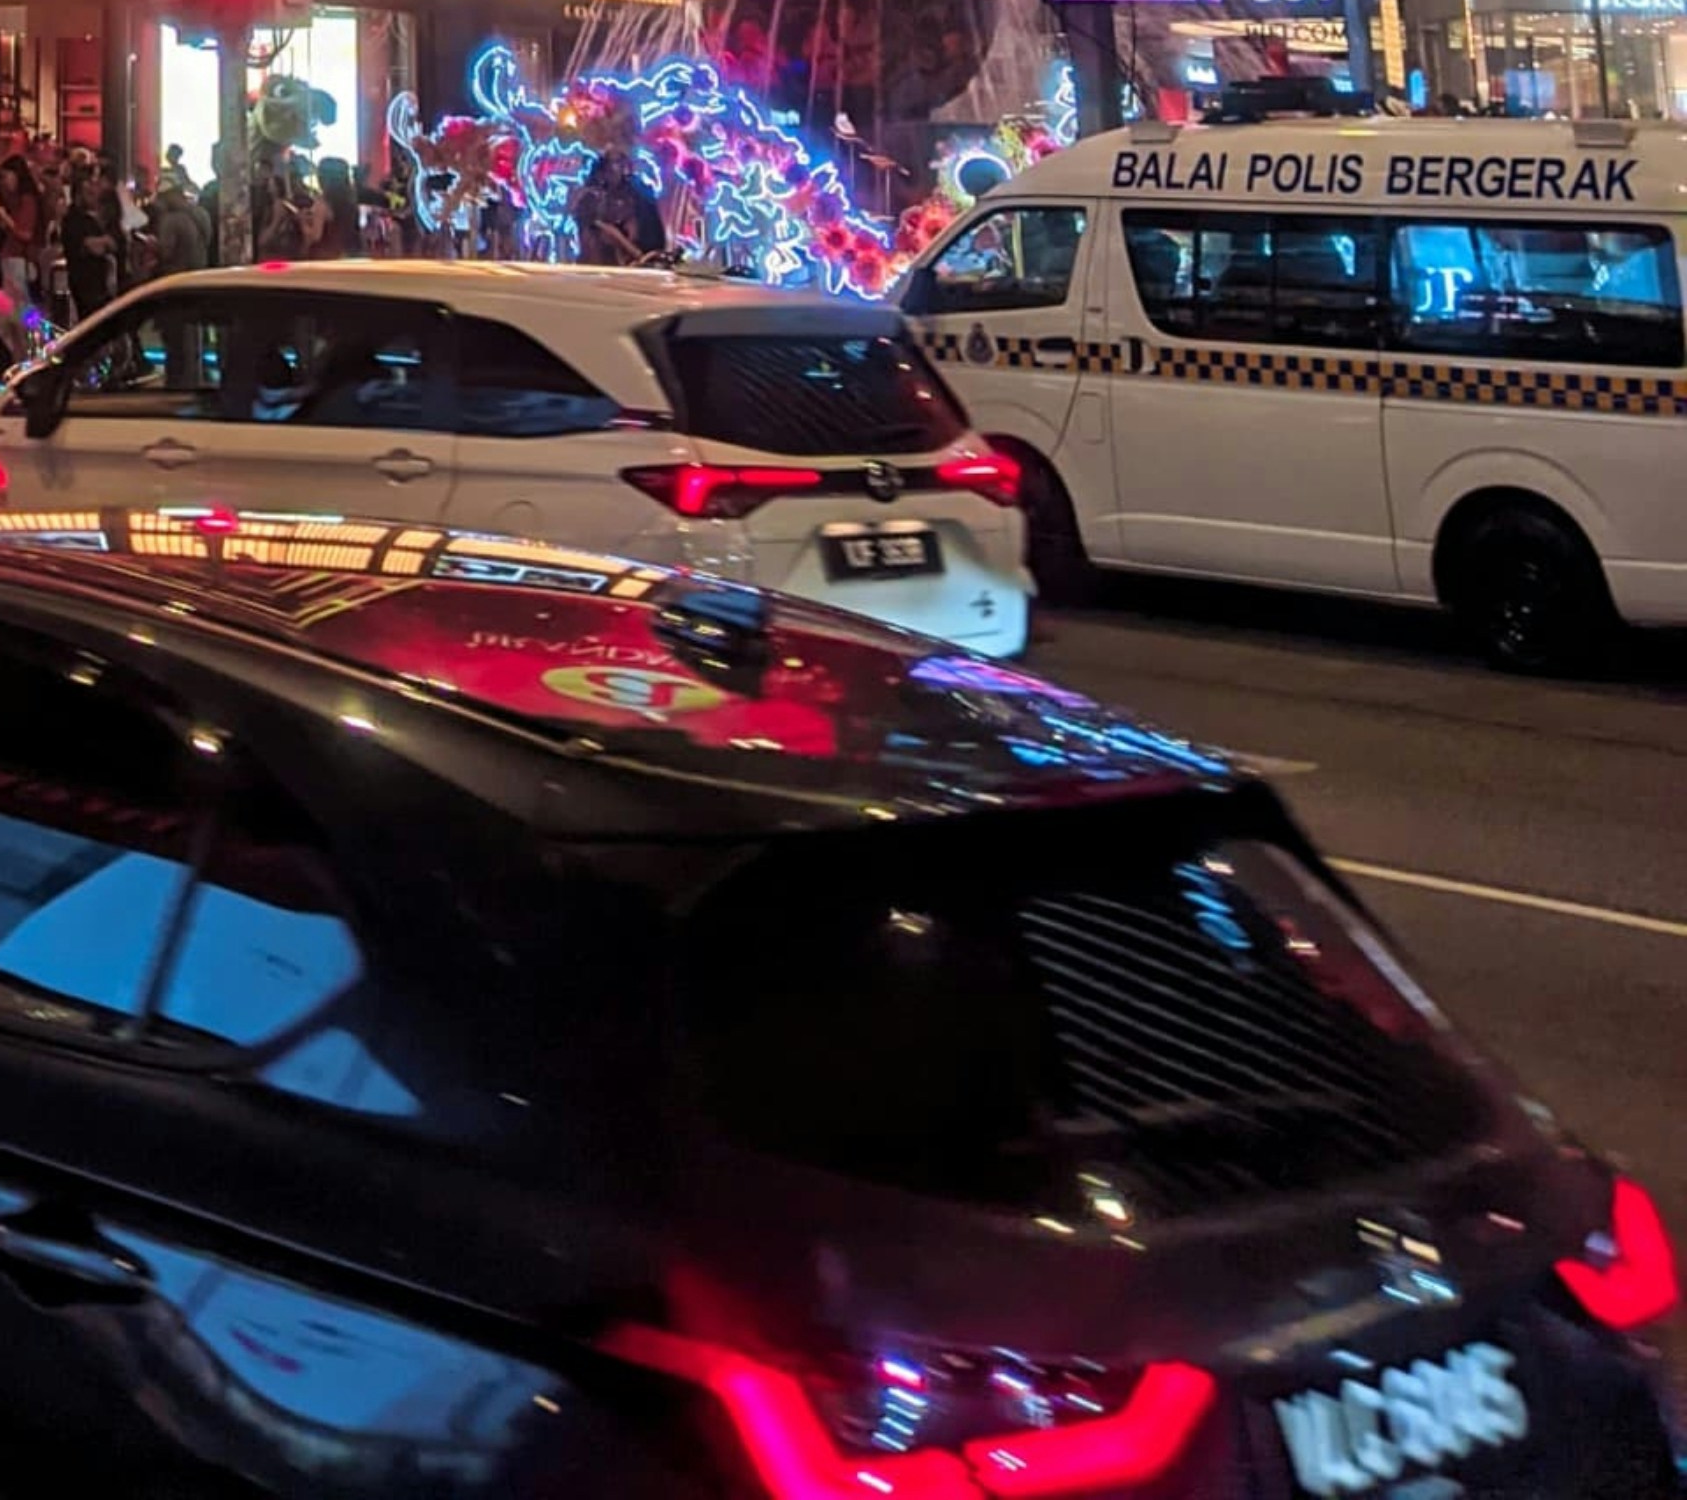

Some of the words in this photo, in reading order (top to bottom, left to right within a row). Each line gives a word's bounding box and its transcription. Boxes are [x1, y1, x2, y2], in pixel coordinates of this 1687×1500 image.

[1113, 150, 1227, 191] BALAI
[1246, 153, 1364, 194] POLIS
[1386, 156, 1639, 202] BERGERAK
